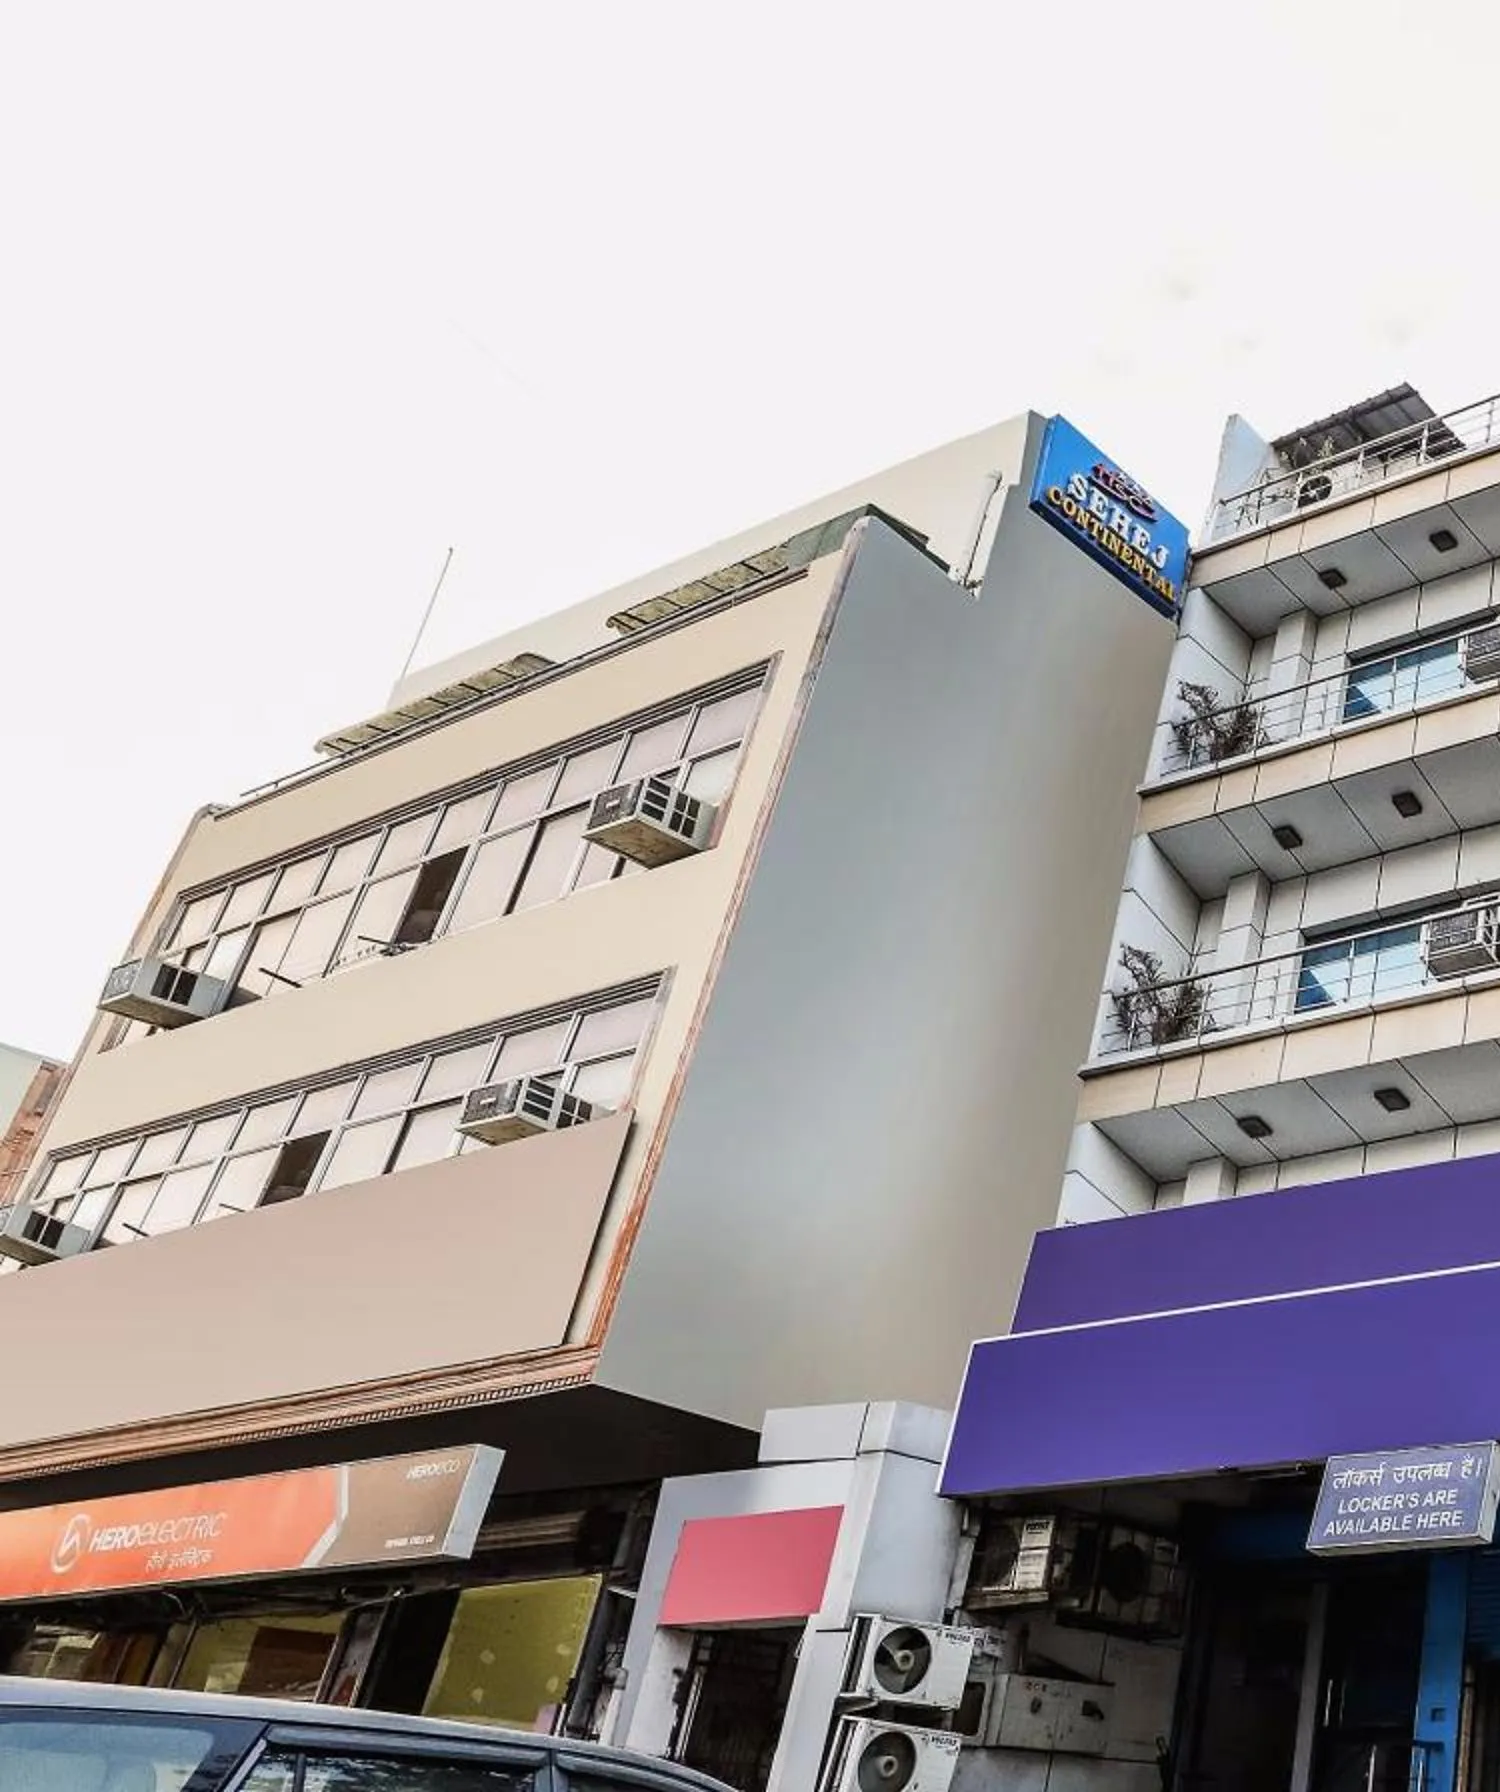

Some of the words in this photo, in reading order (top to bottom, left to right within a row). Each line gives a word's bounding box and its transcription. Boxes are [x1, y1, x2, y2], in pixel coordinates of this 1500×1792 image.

[1046, 486, 1176, 603] CONTINENTAL
[1066, 472, 1170, 569] SEHEJ
[1323, 1514, 1413, 1537] AVAILABLE
[1337, 1492, 1421, 1515] LOCKER'S
[1422, 1488, 1459, 1507] ARE
